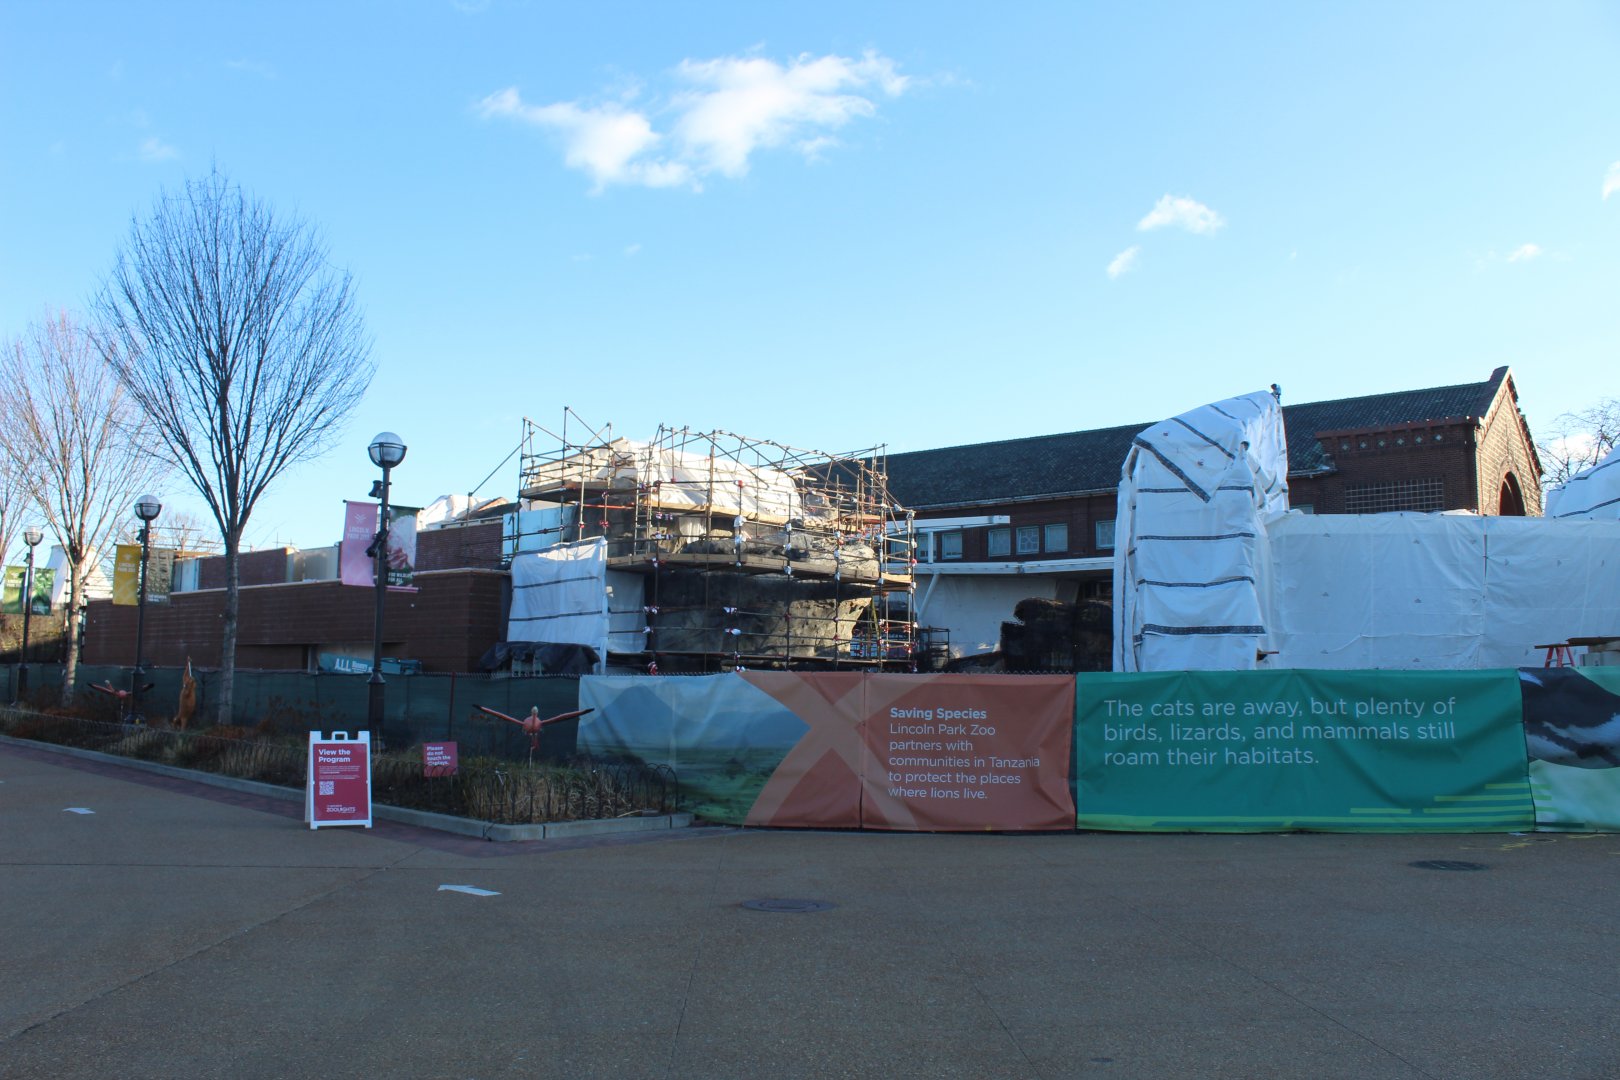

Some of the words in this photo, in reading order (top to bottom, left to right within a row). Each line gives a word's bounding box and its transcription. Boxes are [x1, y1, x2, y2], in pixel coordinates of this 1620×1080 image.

[890, 707, 933, 720] Saving
[936, 708, 987, 721] Species
[1104, 700, 1144, 717] The
[1151, 700, 1195, 717] cats
[1202, 702, 1236, 716] are
[1243, 701, 1303, 718] away,
[1311, 697, 1347, 715] but
[1355, 697, 1425, 718] plenty
[1433, 697, 1456, 715] of
[890, 723, 935, 735] Lincoln
[938, 724, 967, 735] Park
[970, 724, 996, 736] Zoo
[1104, 723, 1163, 743] birds,
[1170, 723, 1246, 743] lizards,
[1253, 722, 1294, 740] and
[1302, 722, 1411, 740] mammals
[1416, 721, 1456, 739] still
[889, 740, 942, 752] partners
[945, 740, 974, 751] with
[318, 756, 351, 764] Program
[888, 755, 970, 768] communities
[974, 756, 985, 768] in
[988, 756, 1040, 768] Tanzania
[1104, 752, 1160, 766] roam
[1167, 748, 1218, 766] their
[1225, 746, 1319, 765] habitats.
[888, 771, 902, 782] to
[905, 772, 953, 784] protect
[956, 772, 977, 784] the
[980, 772, 1021, 785] places
[888, 786, 927, 798] where
[930, 787, 960, 799] lions
[963, 787, 988, 799] live.
